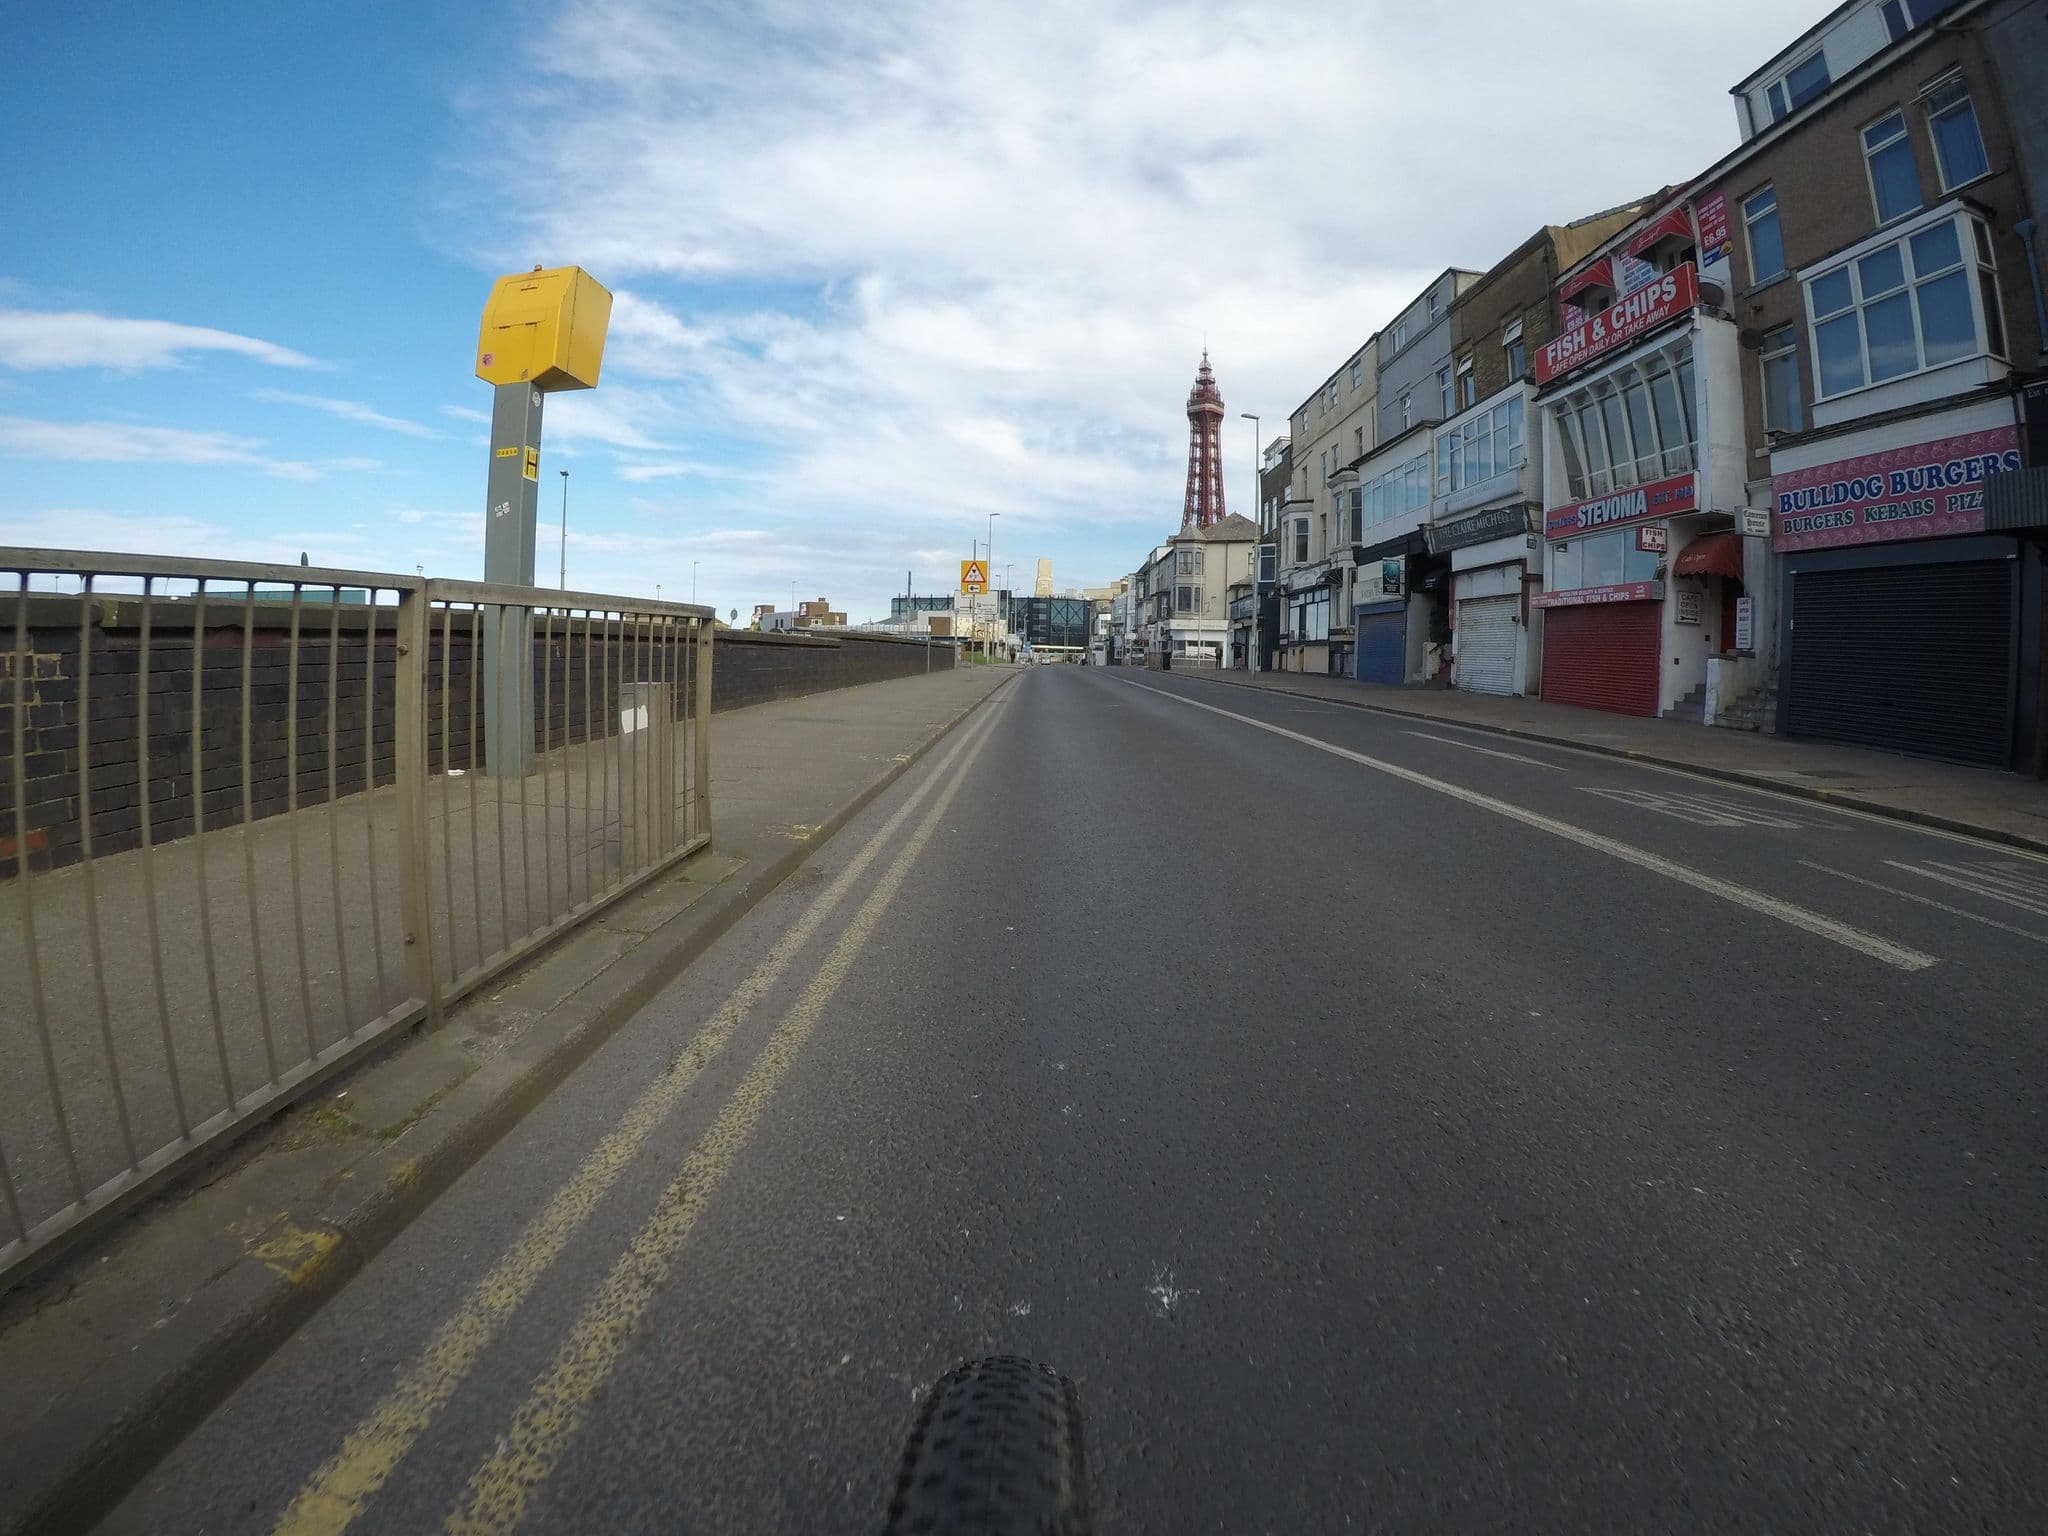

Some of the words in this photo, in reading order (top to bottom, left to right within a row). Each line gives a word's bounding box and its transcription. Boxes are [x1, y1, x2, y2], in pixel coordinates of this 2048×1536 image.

[1546, 331, 1586, 367] FISH
[1592, 318, 1606, 341] &
[1611, 276, 1677, 329] CHIPS
[1551, 357, 1572, 376] CAFE
[1568, 348, 1588, 366] OPEN
[1588, 338, 1611, 355] DAILY
[1611, 329, 1624, 344] OR
[1624, 318, 1646, 336] TAKE
[1645, 302, 1670, 328] AWAY
[1779, 475, 1884, 514] BULLDOG
[1890, 449, 2021, 495] BURGERS
[1452, 519, 1476, 536] CLAIRE
[1577, 490, 1648, 529] STEVONIA
[1783, 511, 1854, 534] BURGERS
[1864, 498, 1934, 523] KEBABS
[1643, 542, 1666, 550] CHIPS
[1645, 529, 1663, 537] FISH
[1547, 595, 1584, 607] TRADITIONAL
[1586, 595, 1601, 603] FISH
[1609, 591, 1630, 600] CHIPS
